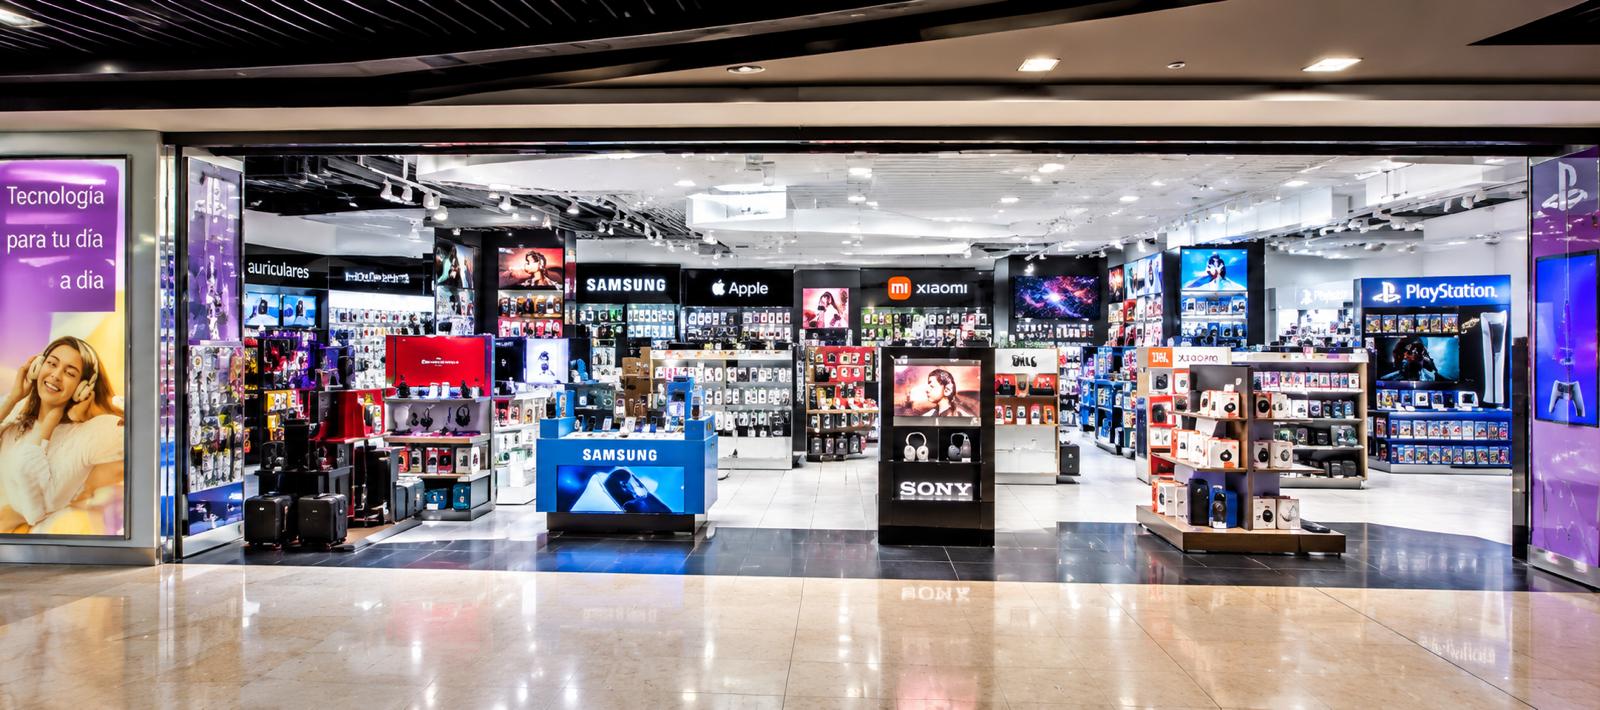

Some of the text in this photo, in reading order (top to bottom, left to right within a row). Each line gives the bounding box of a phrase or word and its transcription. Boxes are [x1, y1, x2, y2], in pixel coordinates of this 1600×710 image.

[6, 185, 104, 210] Tecnología
[7, 228, 103, 254] para tu día
[247, 260, 310, 280] auriculares
[60, 269, 104, 289] a dia
[586, 278, 666, 292] SAMSUNG
[728, 281, 769, 297] Apple
[915, 283, 968, 294] xiaomi
[582, 448, 657, 462] SAMSUNG
[900, 481, 972, 496] SONY
